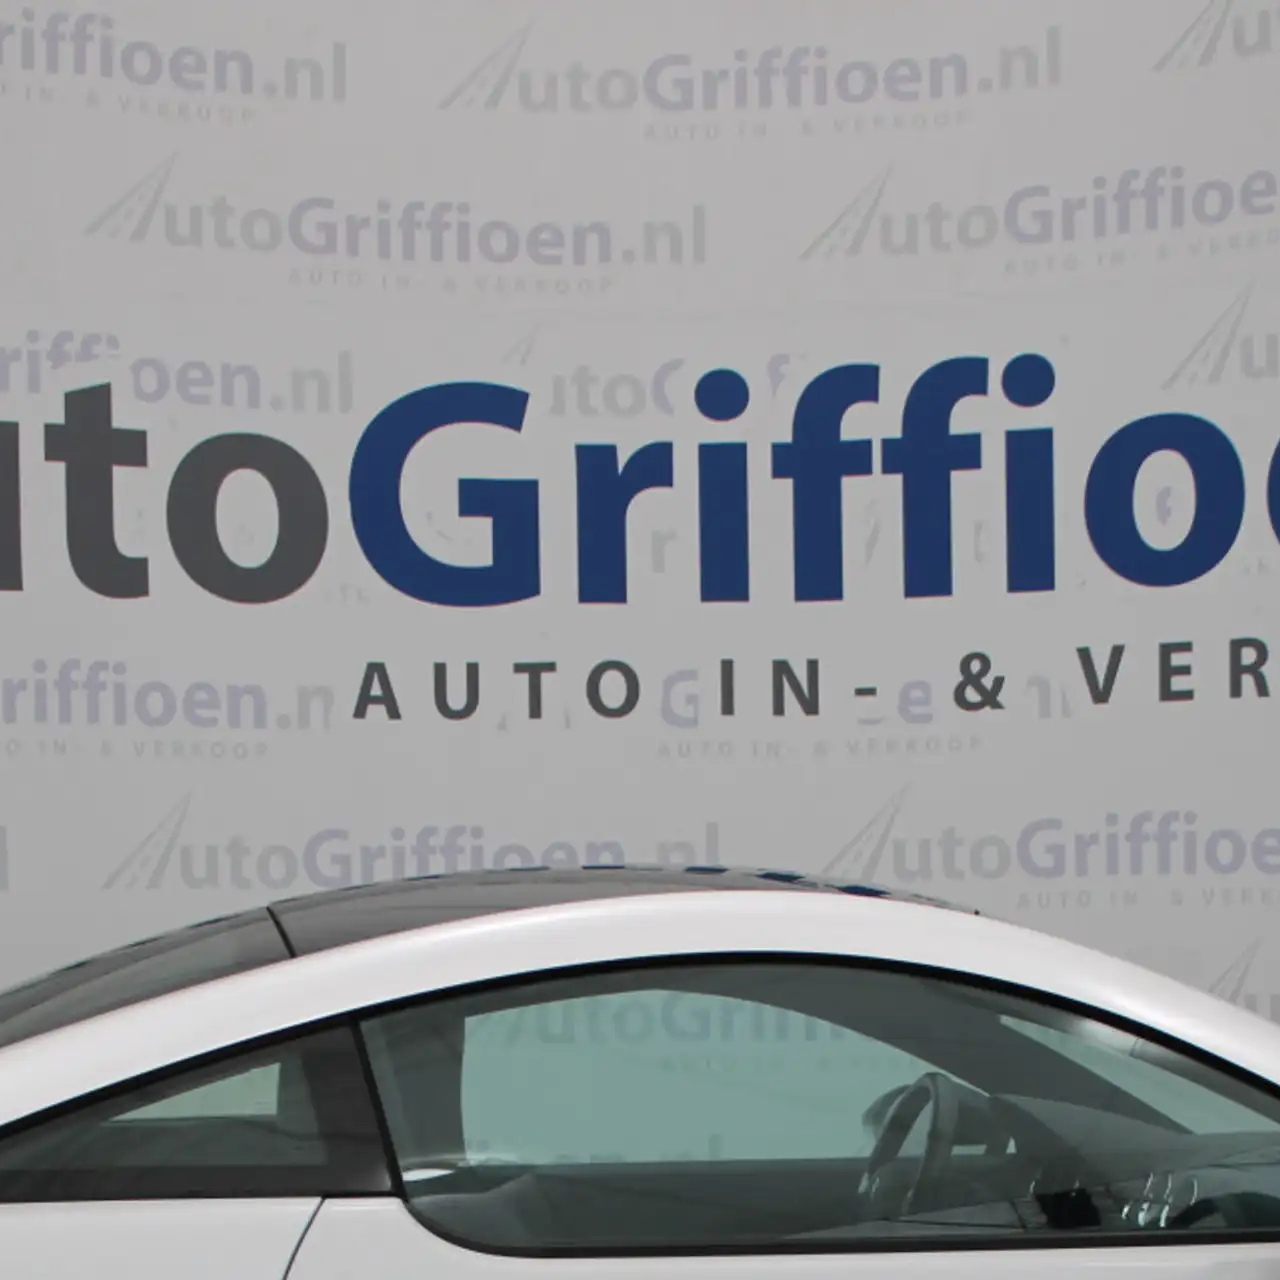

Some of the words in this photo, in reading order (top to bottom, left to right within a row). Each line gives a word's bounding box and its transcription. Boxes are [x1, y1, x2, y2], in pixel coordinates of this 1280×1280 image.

[353, 661, 640, 721] AUTO
[721, 657, 880, 717] IN-
[952, 651, 1007, 712] &
